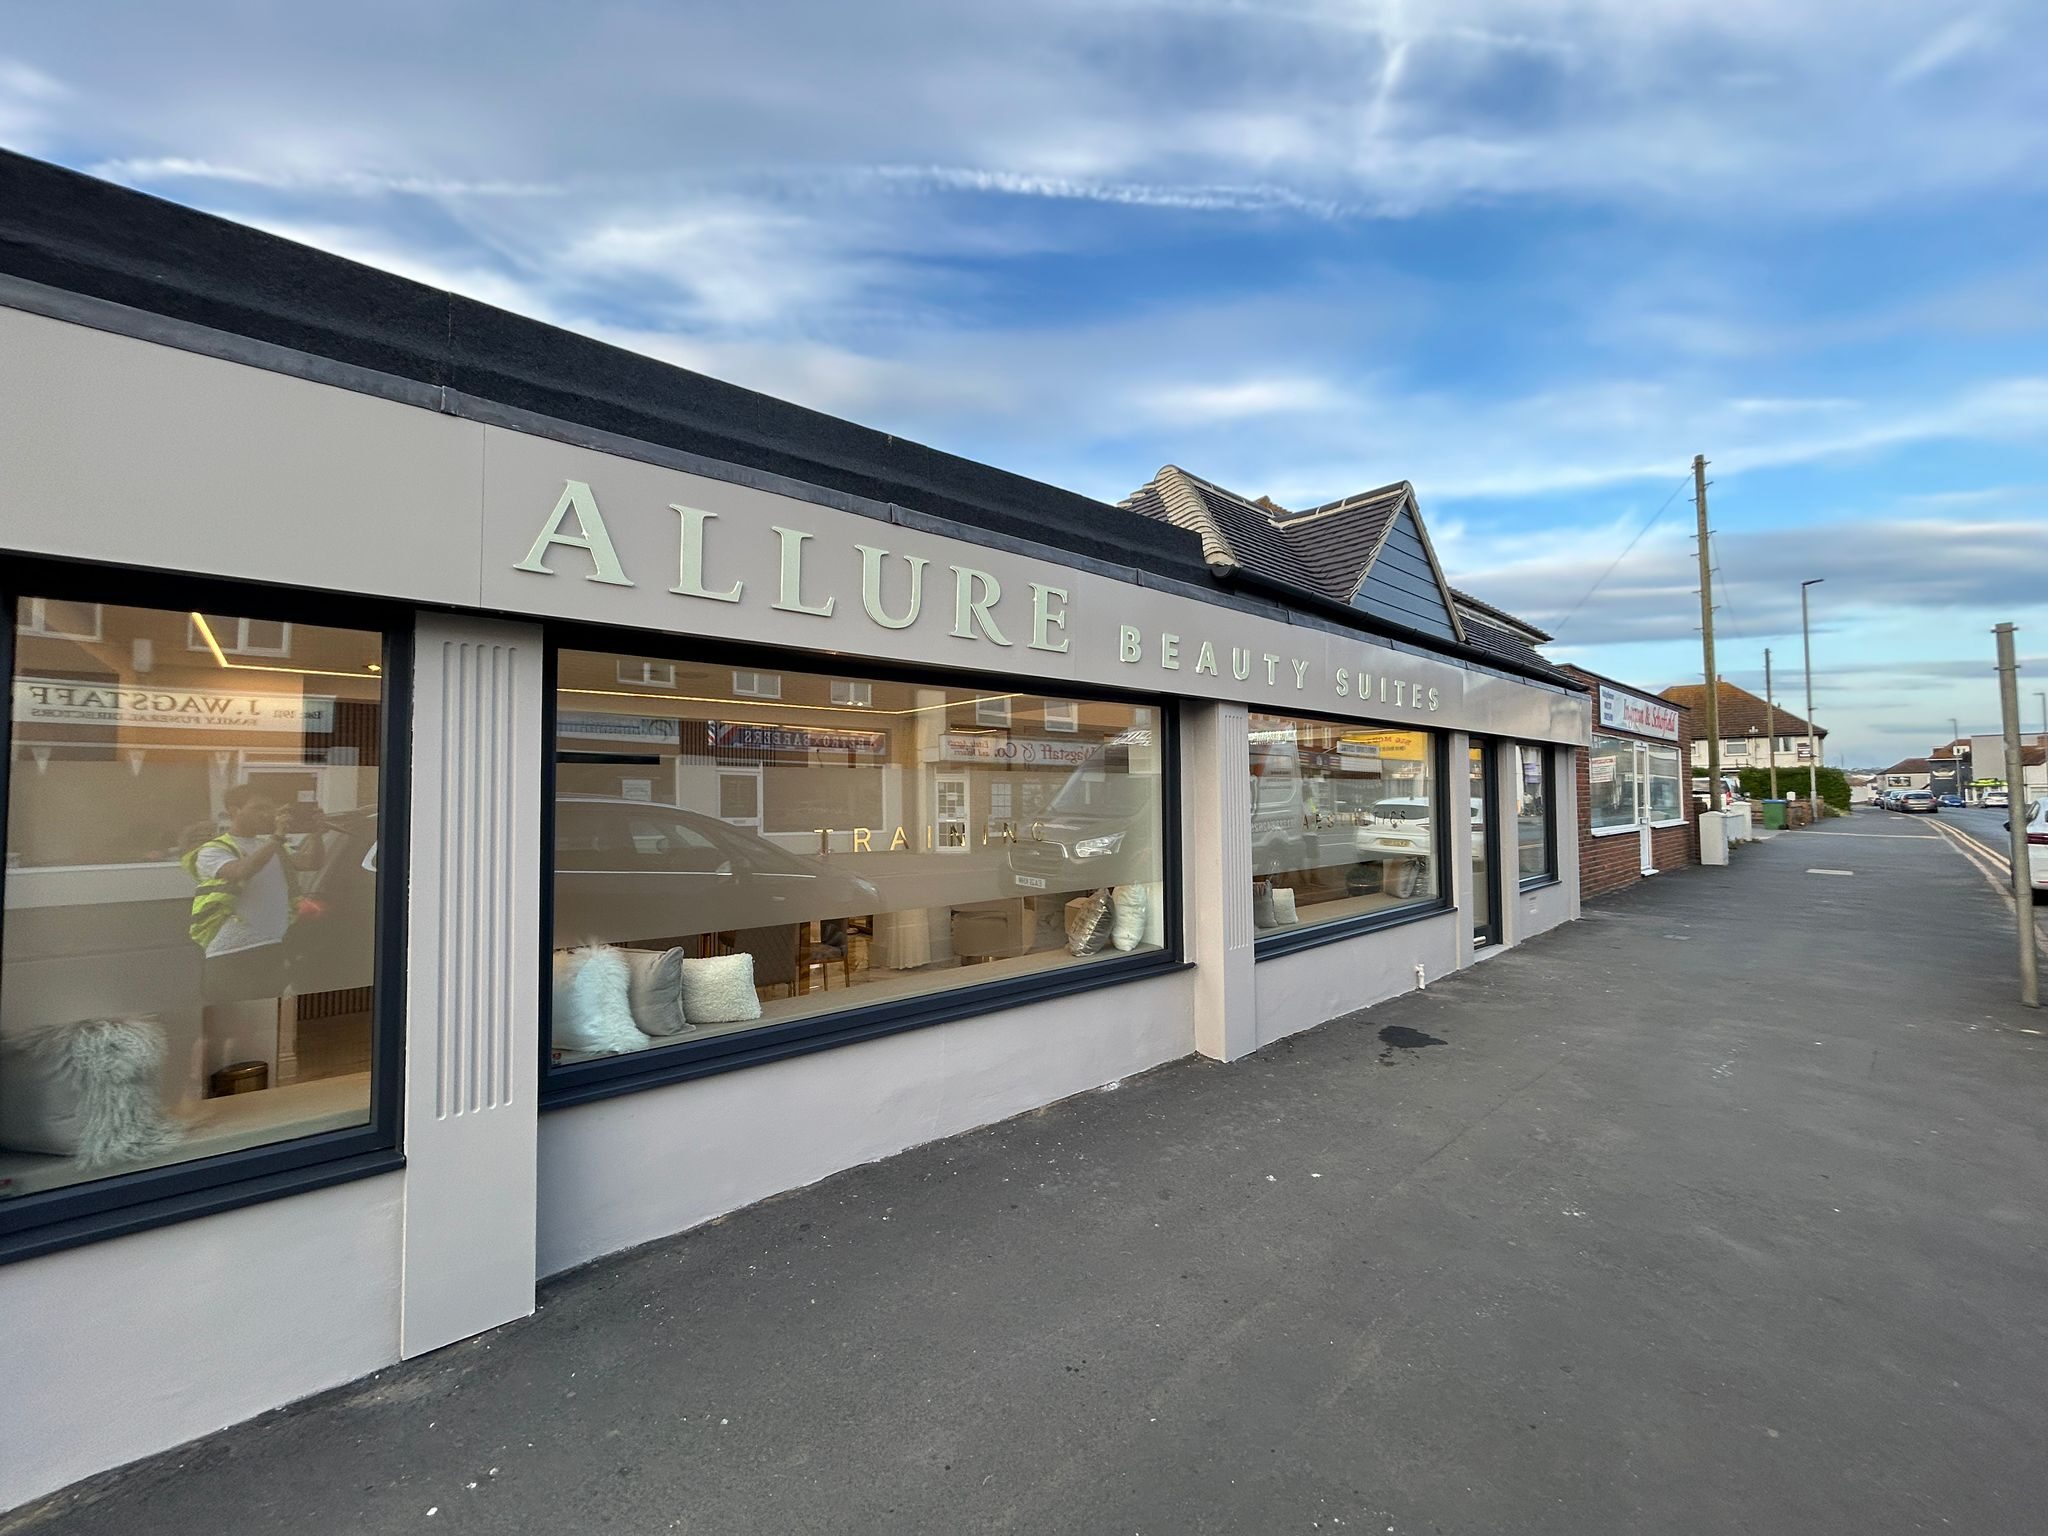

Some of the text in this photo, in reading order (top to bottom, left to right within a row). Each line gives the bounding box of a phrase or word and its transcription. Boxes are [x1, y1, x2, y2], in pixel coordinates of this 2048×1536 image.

[512, 479, 1440, 712] ALLURE BEAUTY SUITES
[813, 819, 1045, 856] TRAINING
